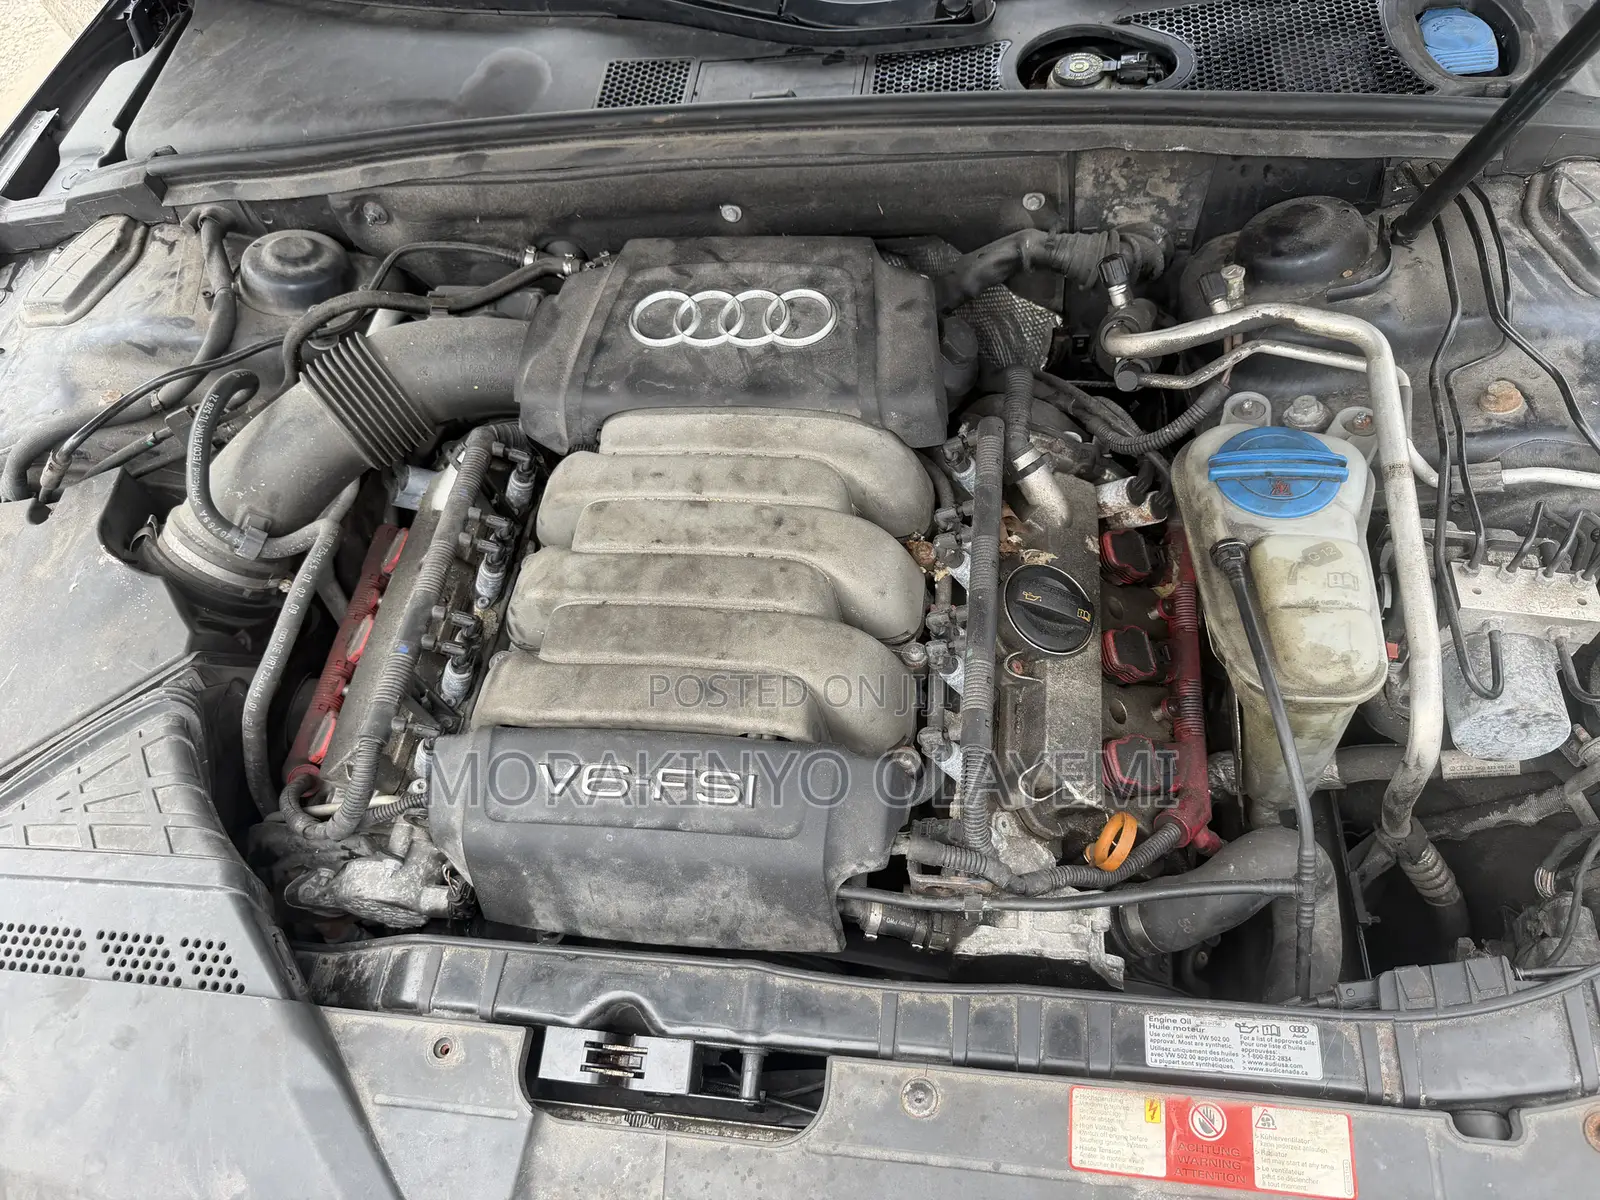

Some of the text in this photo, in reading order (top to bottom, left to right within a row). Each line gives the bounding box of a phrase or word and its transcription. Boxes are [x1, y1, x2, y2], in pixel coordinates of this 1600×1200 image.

[1320, 546, 1336, 556] 12
[1148, 1016, 1177, 1025] Engine
[1173, 1025, 1205, 1033] moteur
[1275, 1037, 1303, 1045] approved
[1172, 1047, 1208, 1055] uniquement
[1248, 1060, 1303, 1069] www.audiusa.com
[1248, 1066, 1308, 1076] www.audicanada.ca
[1177, 1142, 1240, 1156] ACHTUNG
[1177, 1156, 1241, 1170] WARNING
[1174, 1168, 1246, 1183] ATTENTION
